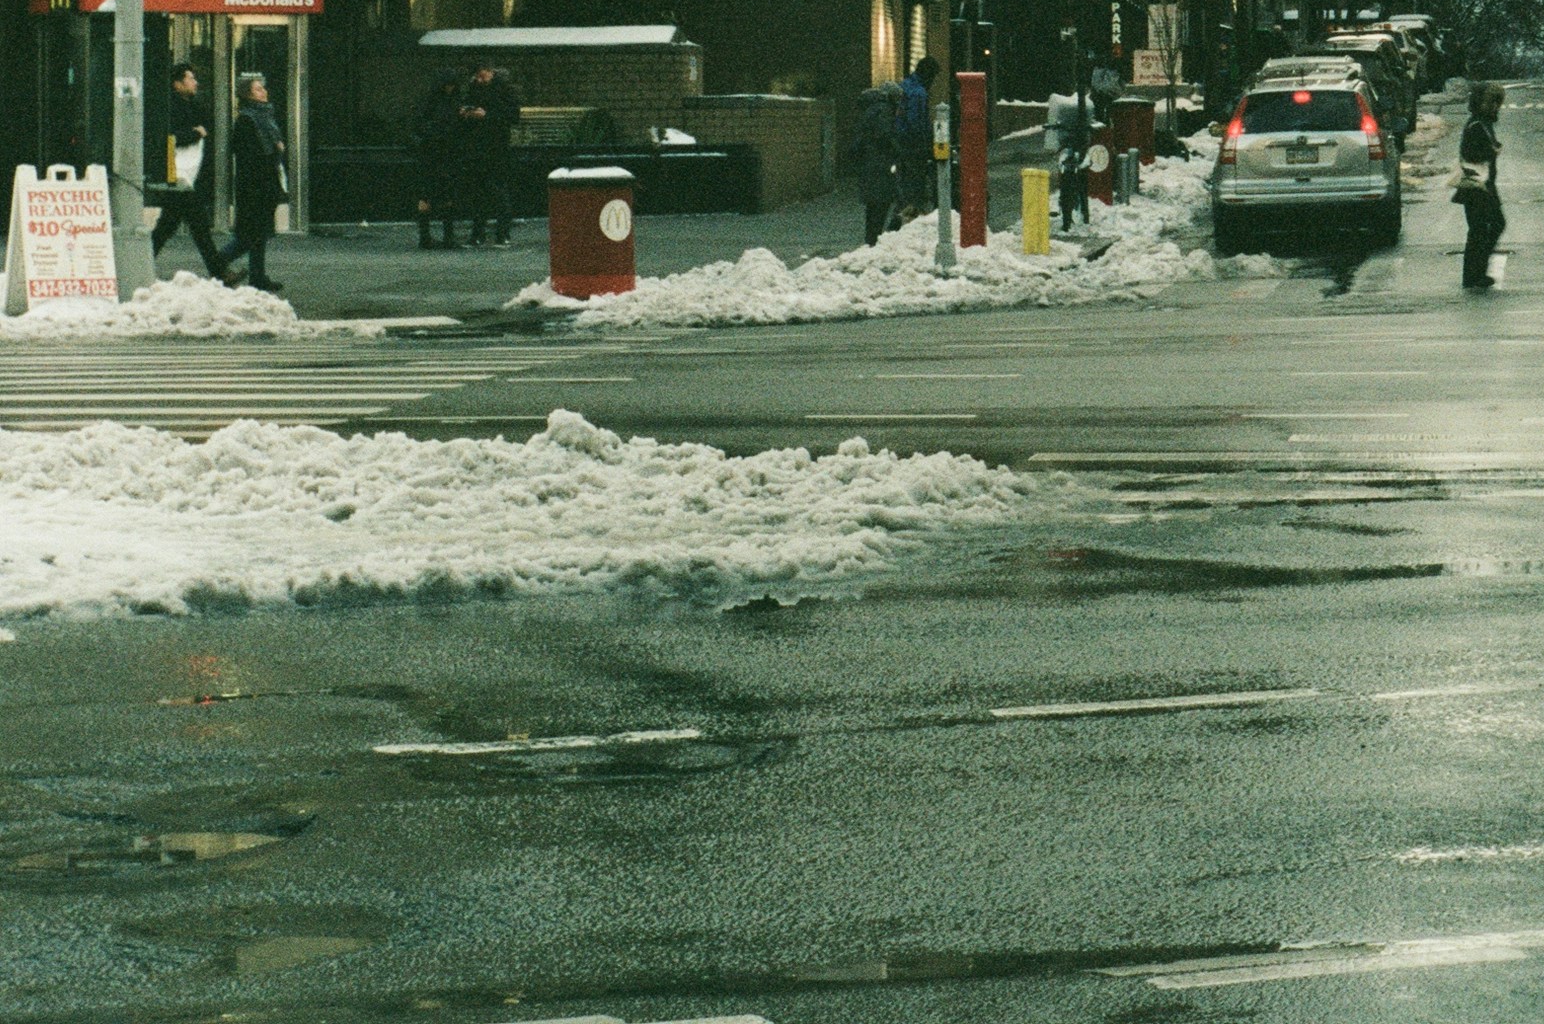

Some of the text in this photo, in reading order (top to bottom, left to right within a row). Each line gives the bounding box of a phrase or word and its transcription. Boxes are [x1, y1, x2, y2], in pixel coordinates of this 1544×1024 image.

[1111, 2, 1121, 44] PARK
[27, 190, 104, 203] PSYCHIC
[28, 204, 106, 217] READING
[27, 219, 107, 240] $10 Special
